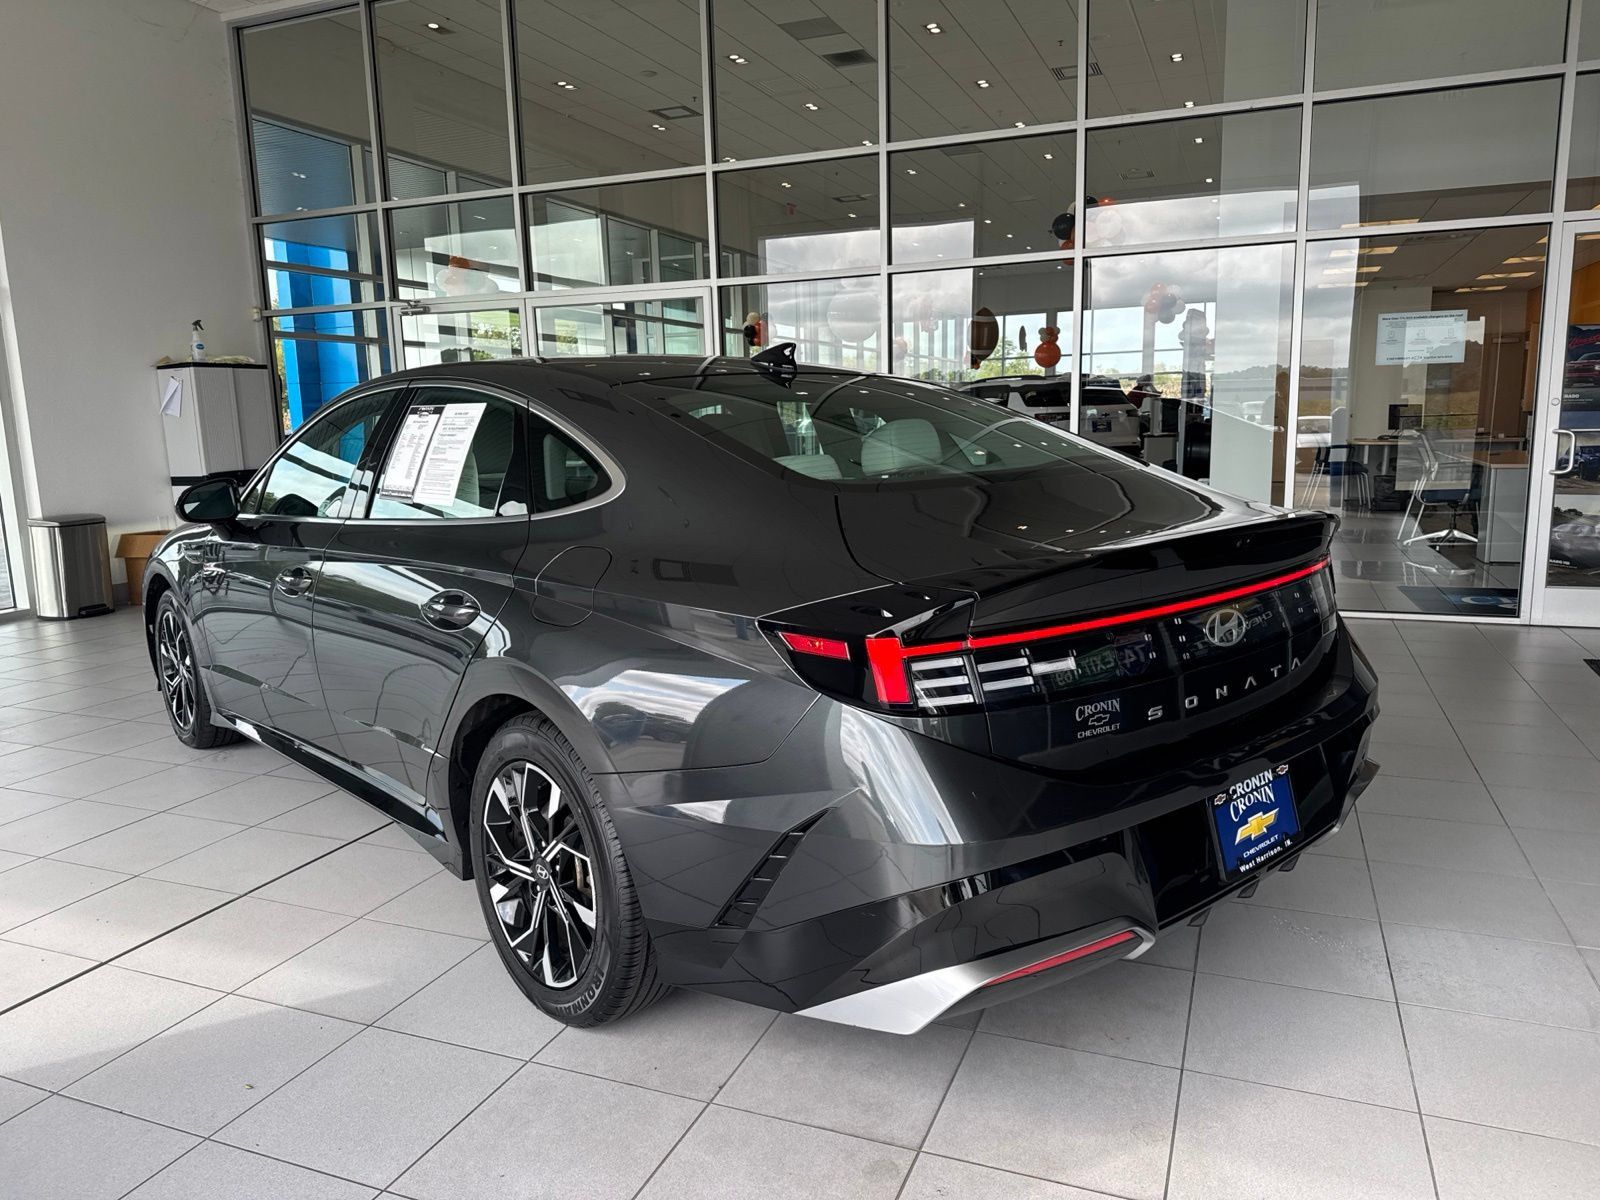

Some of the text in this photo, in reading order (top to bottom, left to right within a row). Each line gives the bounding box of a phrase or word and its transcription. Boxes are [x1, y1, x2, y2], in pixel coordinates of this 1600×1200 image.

[1147, 657, 1300, 720] SONATA
[1075, 698, 1120, 722] CRONIN
[1077, 723, 1120, 739] CHEVROLET
[1229, 769, 1273, 799] CRONIN
[1230, 784, 1275, 822] CRONIN
[1239, 861, 1256, 873] West
[1256, 846, 1283, 864] Harrison,
[1243, 834, 1278, 858] CHEVROLET
